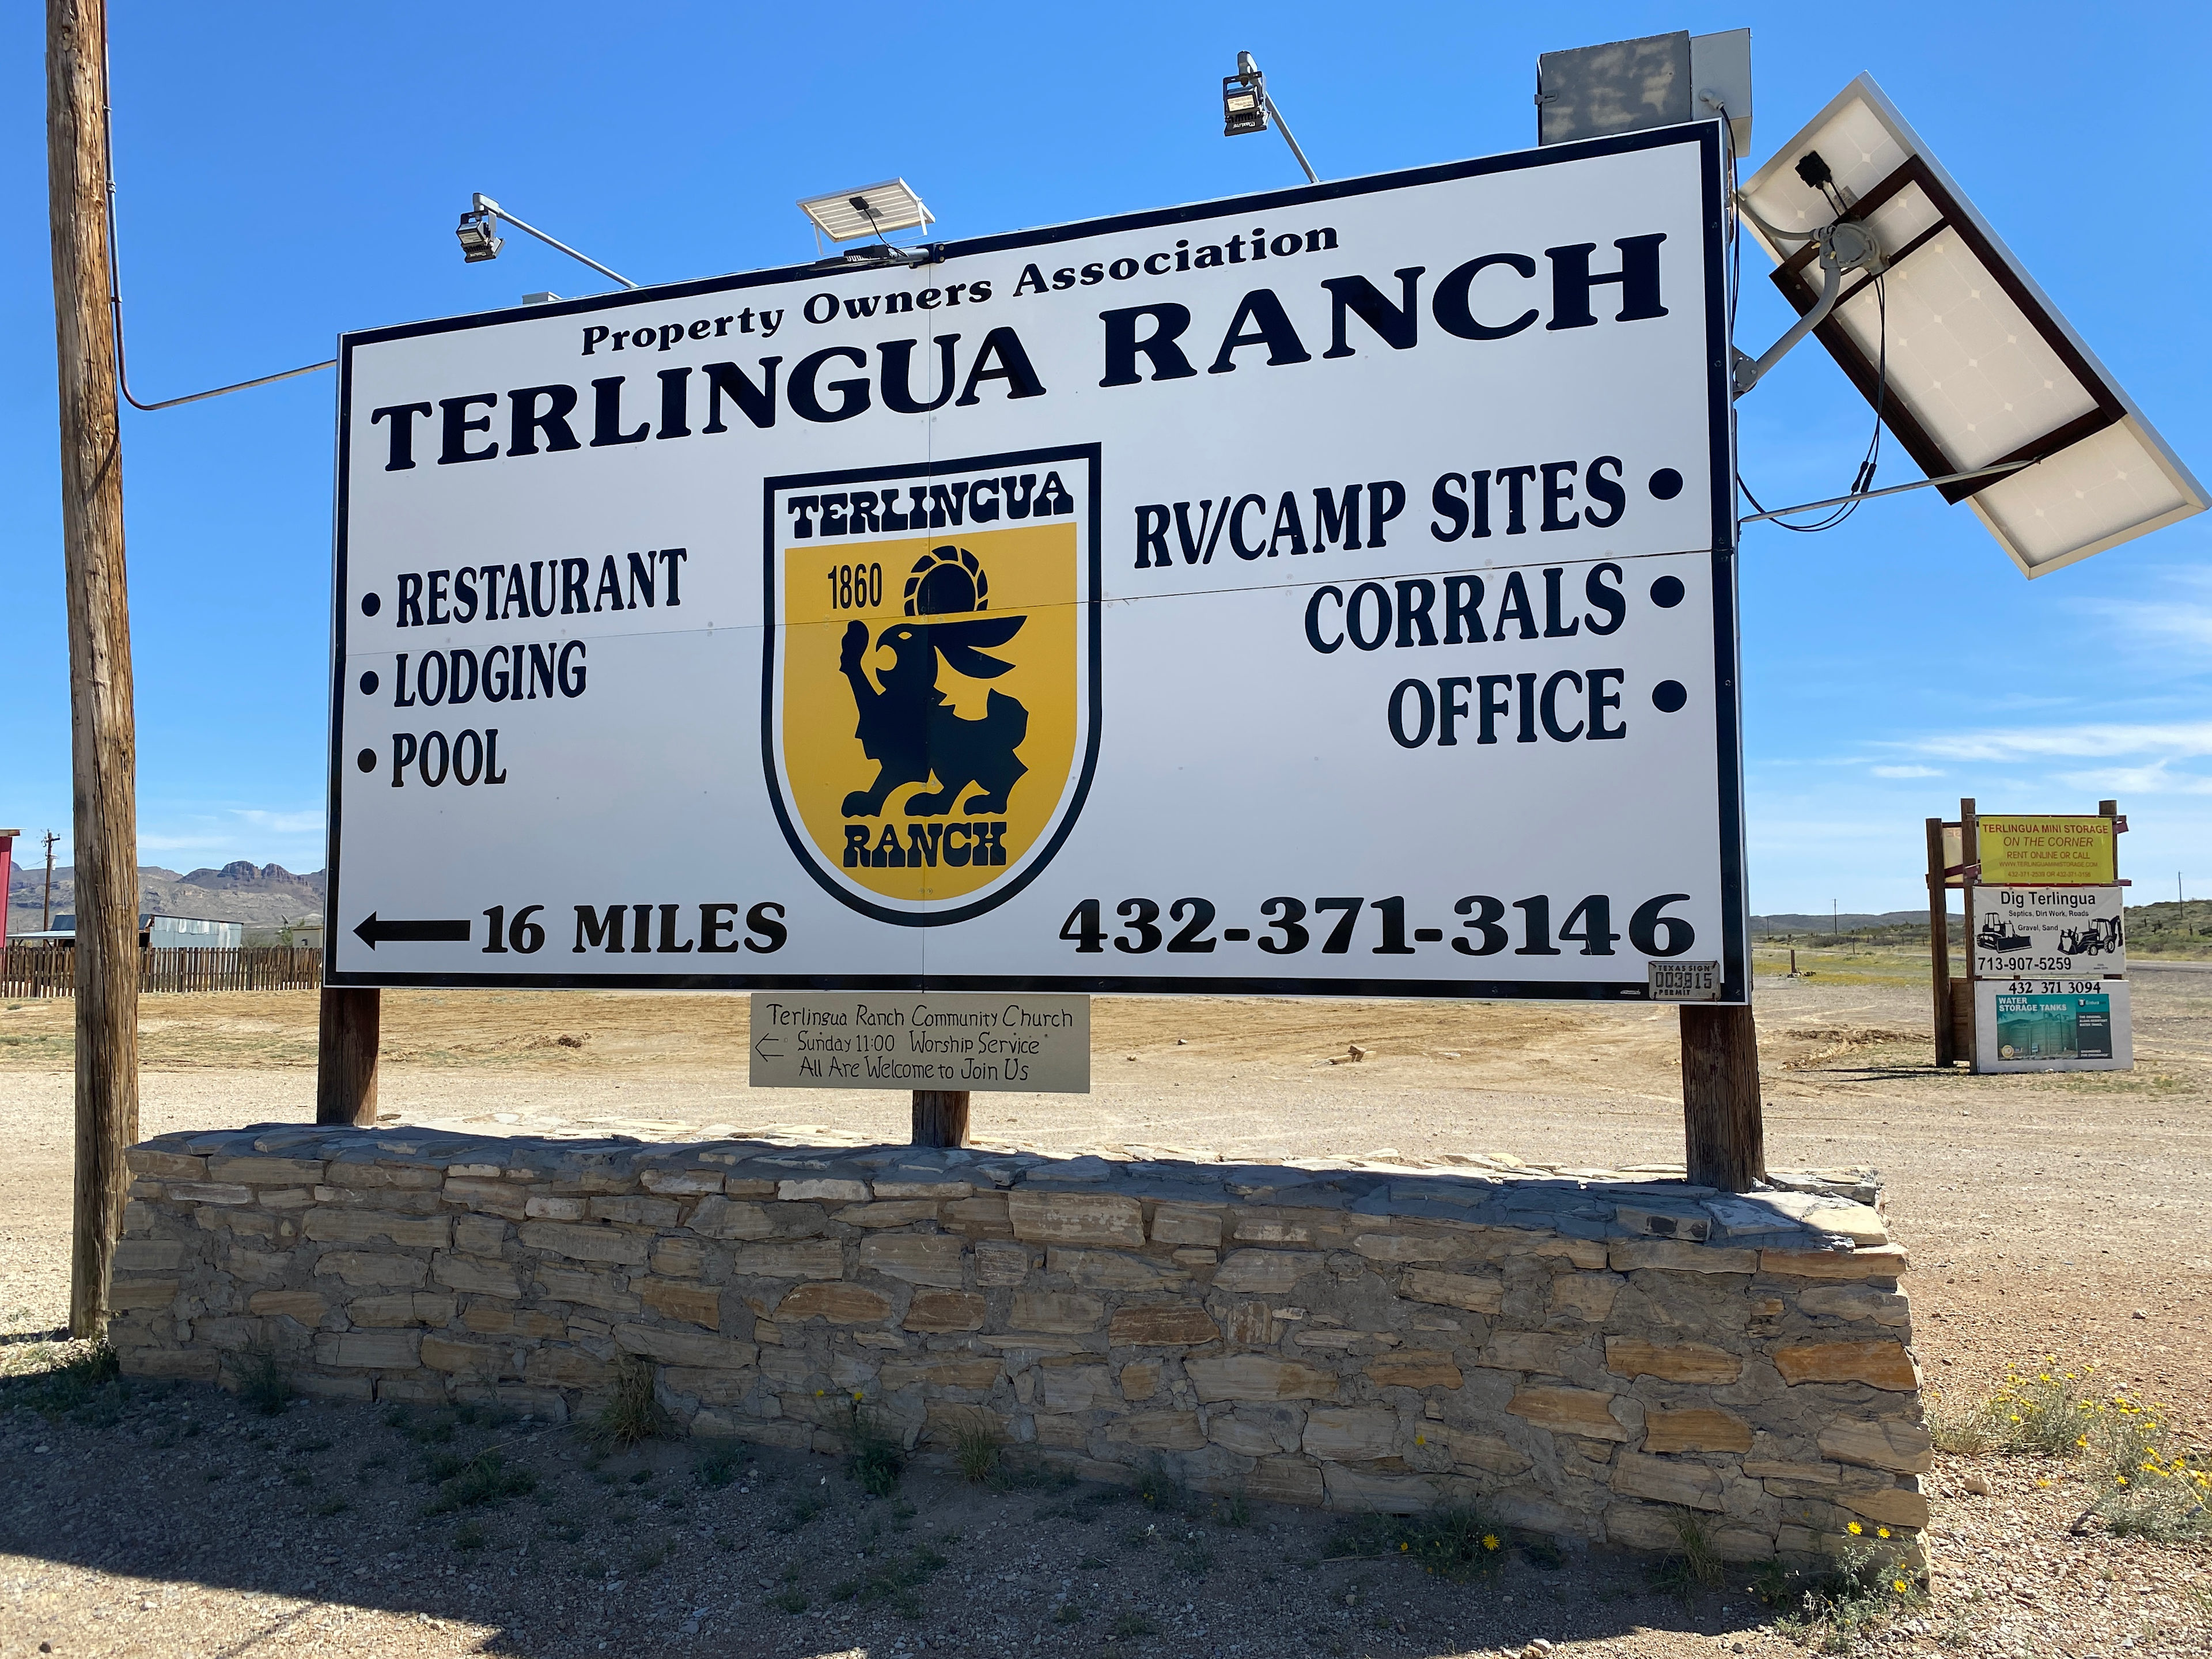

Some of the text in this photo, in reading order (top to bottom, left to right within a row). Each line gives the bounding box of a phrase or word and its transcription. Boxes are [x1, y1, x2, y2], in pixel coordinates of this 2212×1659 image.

[582, 228, 1338, 355] Property Owners Association
[371, 233, 1669, 471] TERLINGUA RANCH
[788, 471, 1073, 539] TERLINGUA
[1135, 456, 1626, 569] RV/CAMP SITES
[397, 548, 687, 627] RESTAURANT
[828, 563, 881, 609] 1860
[1305, 563, 1626, 654] CORRALS
[394, 640, 586, 707] LODGING
[1388, 668, 1626, 748] OFFICE
[392, 729, 506, 787] POOL
[843, 822, 1006, 868] RANCH
[1983, 824, 2108, 834] TERLINGUA MINI STORAGE
[2003, 837, 2093, 847] ON THE CORNER
[2001, 891, 2095, 908] Dig Terlingua
[482, 902, 787, 953] 16 MILES
[1059, 894, 1695, 957] 432-371-3146
[1978, 957, 2072, 971] 713-907-5259
[2009, 982, 2101, 994] 432 371 3094
[766, 1004, 1073, 1028] Terlingua Ranch Community Church
[798, 1031, 1039, 1055] Sunday 11:00 Worship Service
[799, 1055, 1029, 1081] All Are Welcome to Join Us
